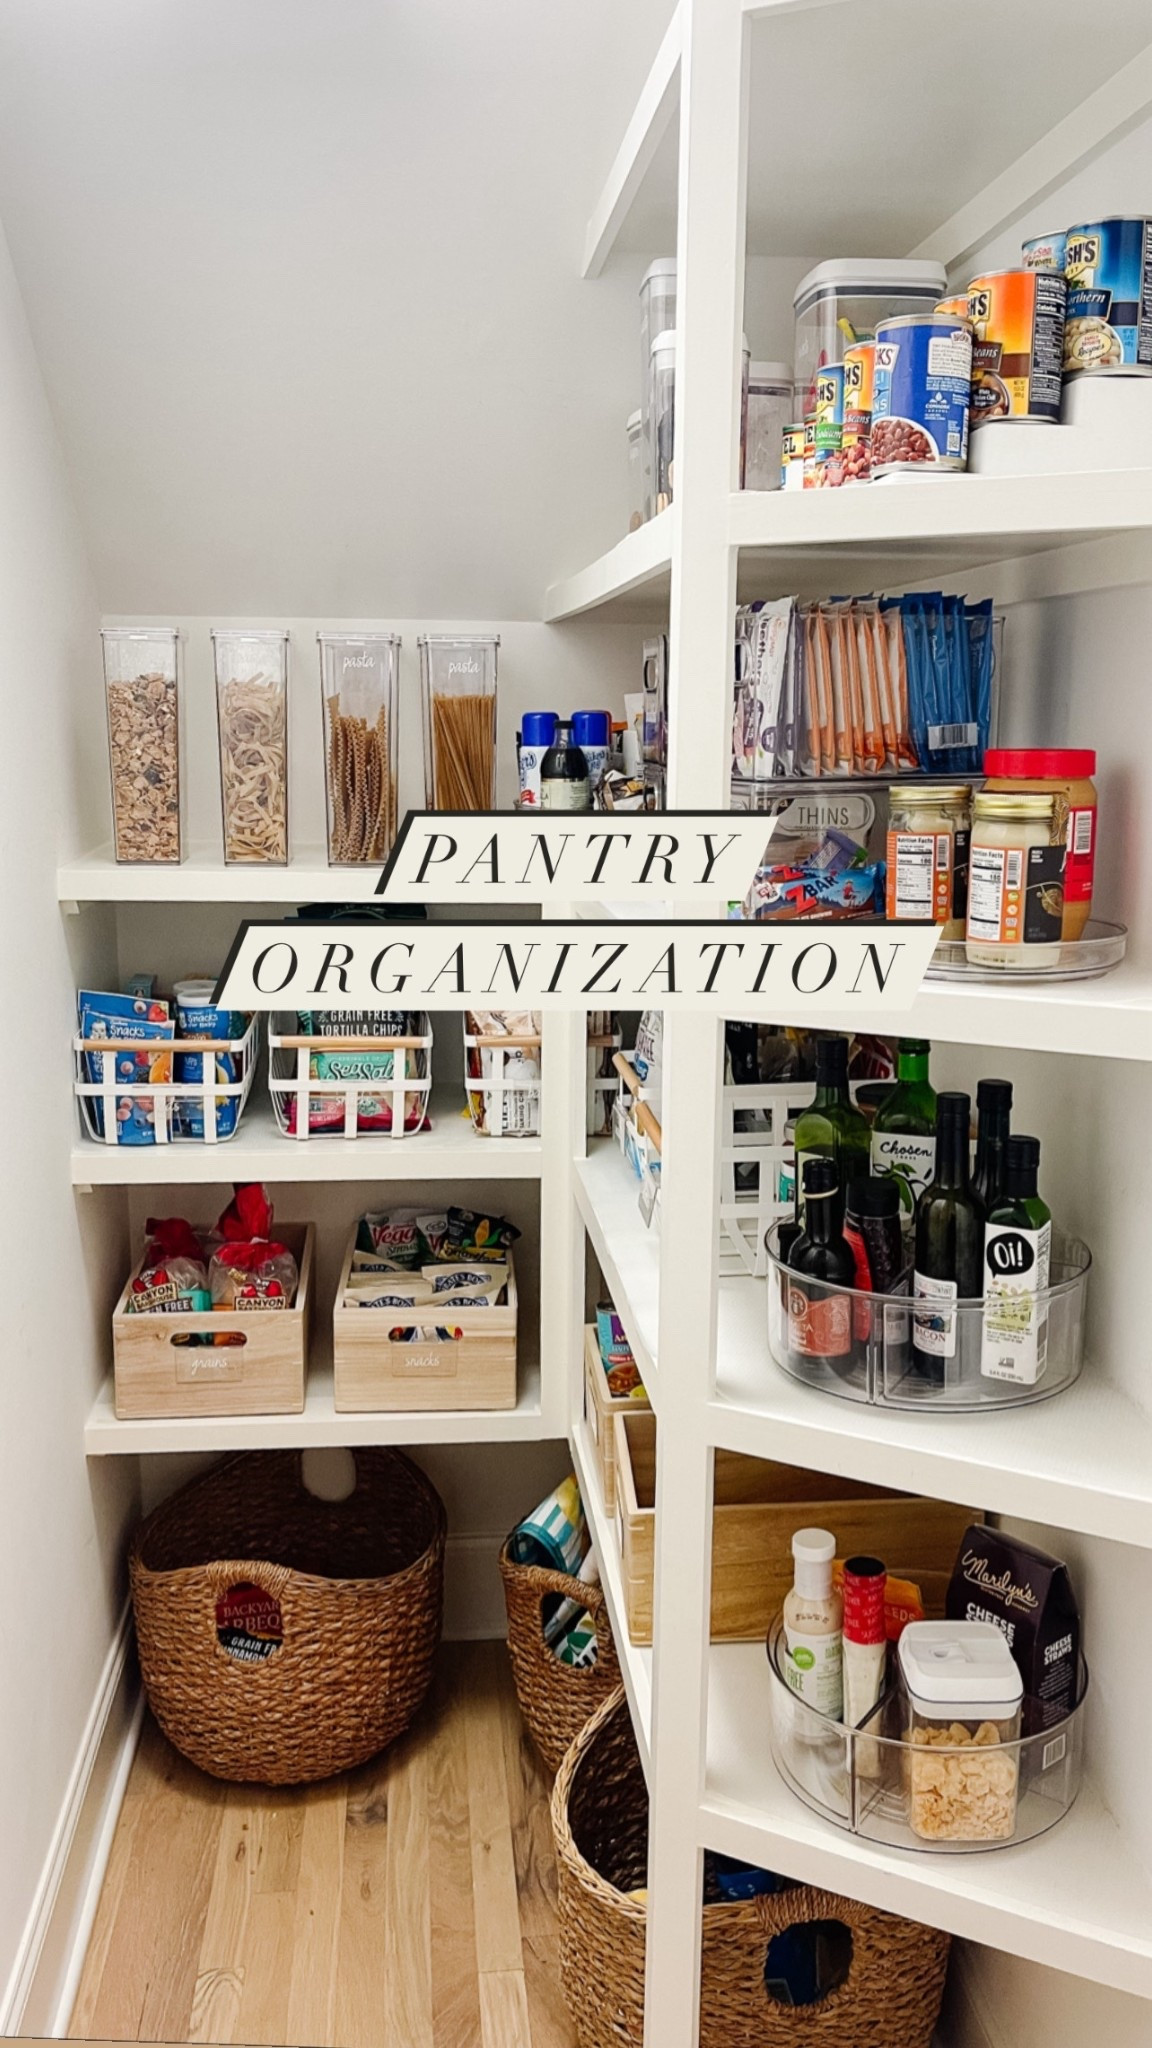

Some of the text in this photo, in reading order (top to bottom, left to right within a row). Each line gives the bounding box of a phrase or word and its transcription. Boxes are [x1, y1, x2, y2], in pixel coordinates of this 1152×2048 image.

[343, 651, 375, 674] pasta
[448, 656, 480, 680] pasta
[798, 806, 850, 826] THINS
[330, 1010, 393, 1022] GRAIN FREE
[110, 1025, 145, 1037] Snacks
[320, 1023, 403, 1036] TORTILLA CHIPS
[880, 1139, 932, 1157] Chosen
[993, 1240, 1024, 1269] Oi!
[133, 1284, 174, 1303] CANYON
[237, 1298, 285, 1307] CANYON
[165, 1299, 190, 1312] FREE
[192, 1358, 227, 1375] grains
[404, 1351, 440, 1368] snacks
[962, 1550, 1038, 1607] Marilyn's
[966, 1602, 1016, 1636] CHEESE
[231, 1636, 263, 1653] GRAIN
[1044, 1633, 1072, 1656] CHEESE
[1044, 1644, 1072, 1666] STRAWS
